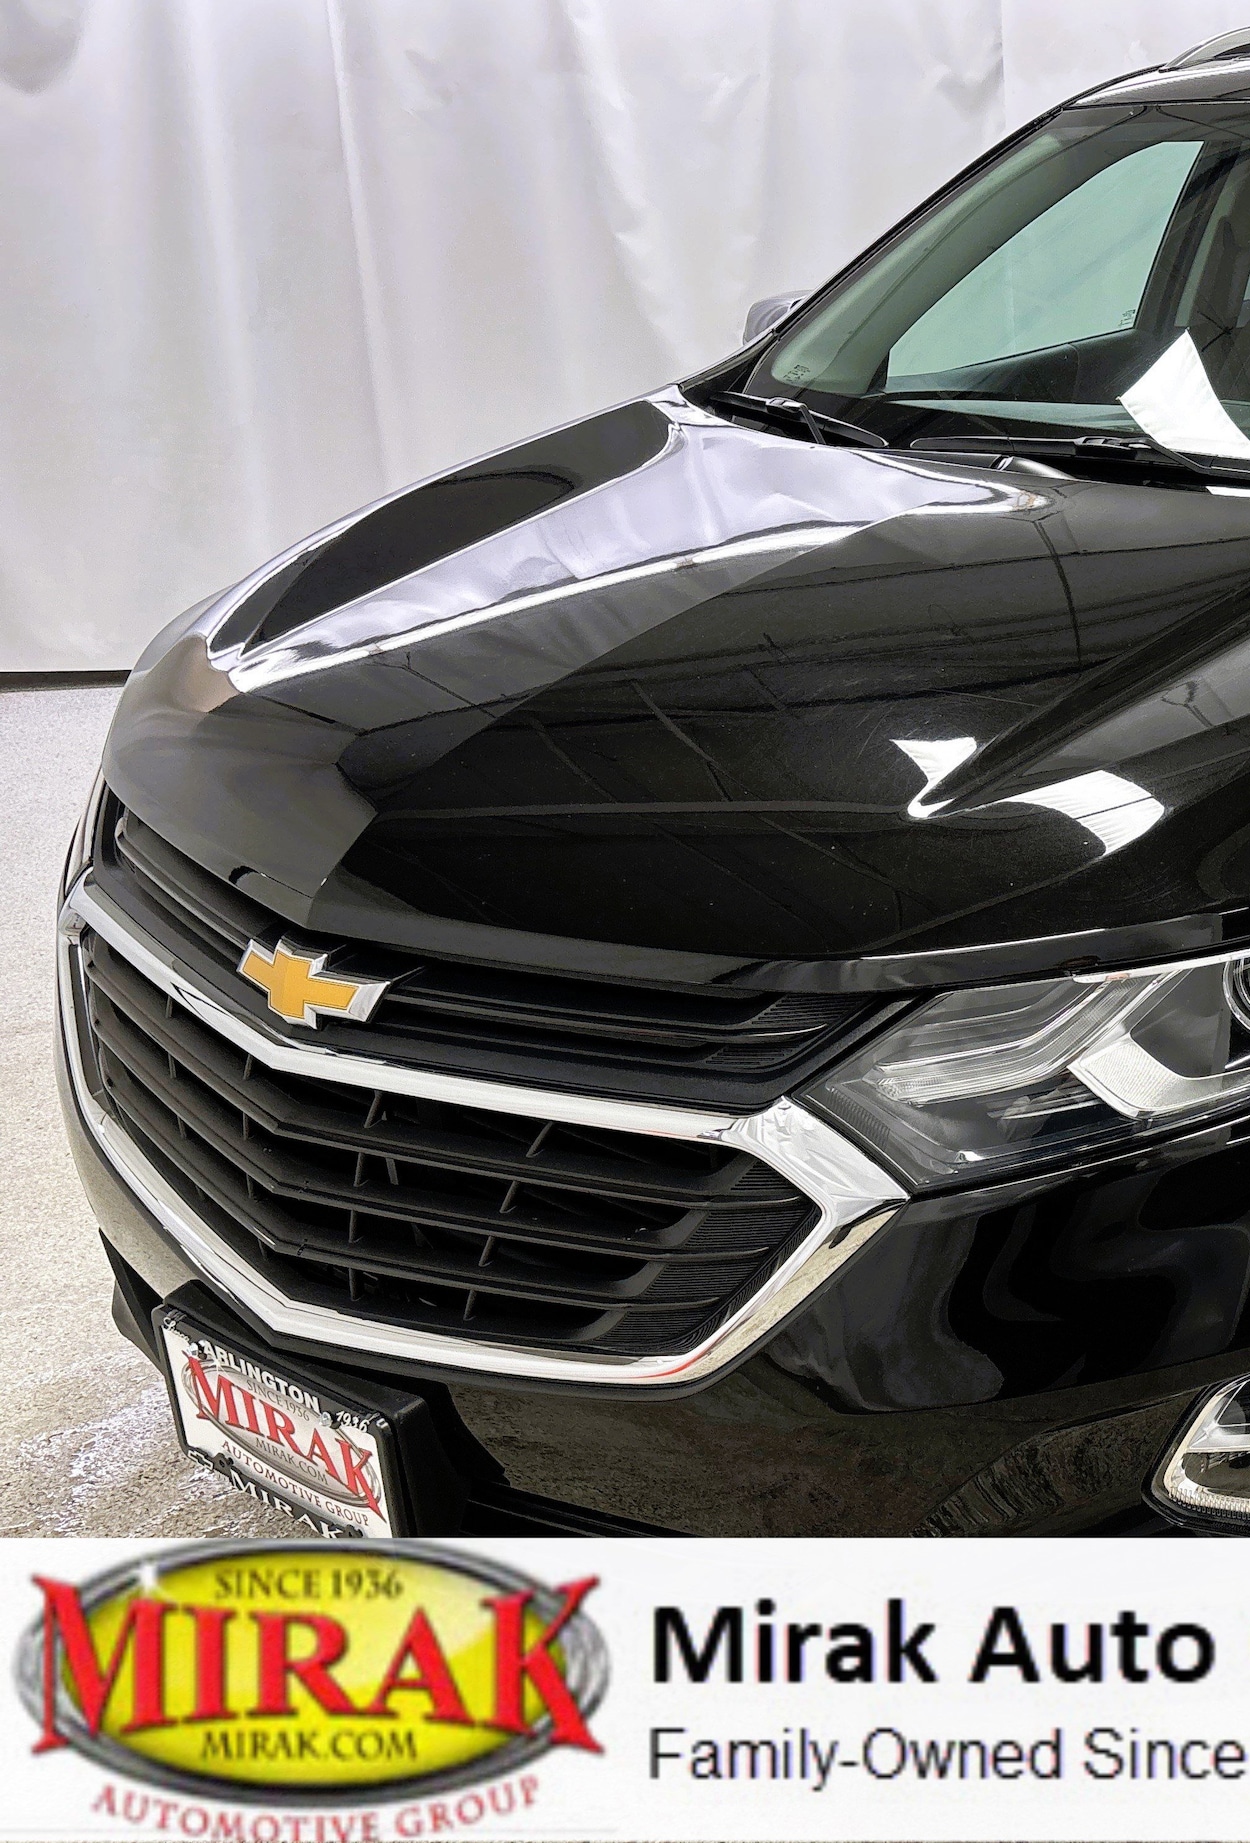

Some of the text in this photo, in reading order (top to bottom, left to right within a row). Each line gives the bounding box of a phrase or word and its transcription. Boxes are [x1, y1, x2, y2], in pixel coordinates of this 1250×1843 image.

[246, 1379, 310, 1421] SINCE 1936
[335, 1410, 370, 1433] 1936
[182, 1349, 387, 1523] MIRAK
[256, 1437, 330, 1486] MIRAK.COM
[221, 1440, 369, 1527] AUTOMOTIVE GROUP
[231, 1470, 343, 1538] MIRAK
